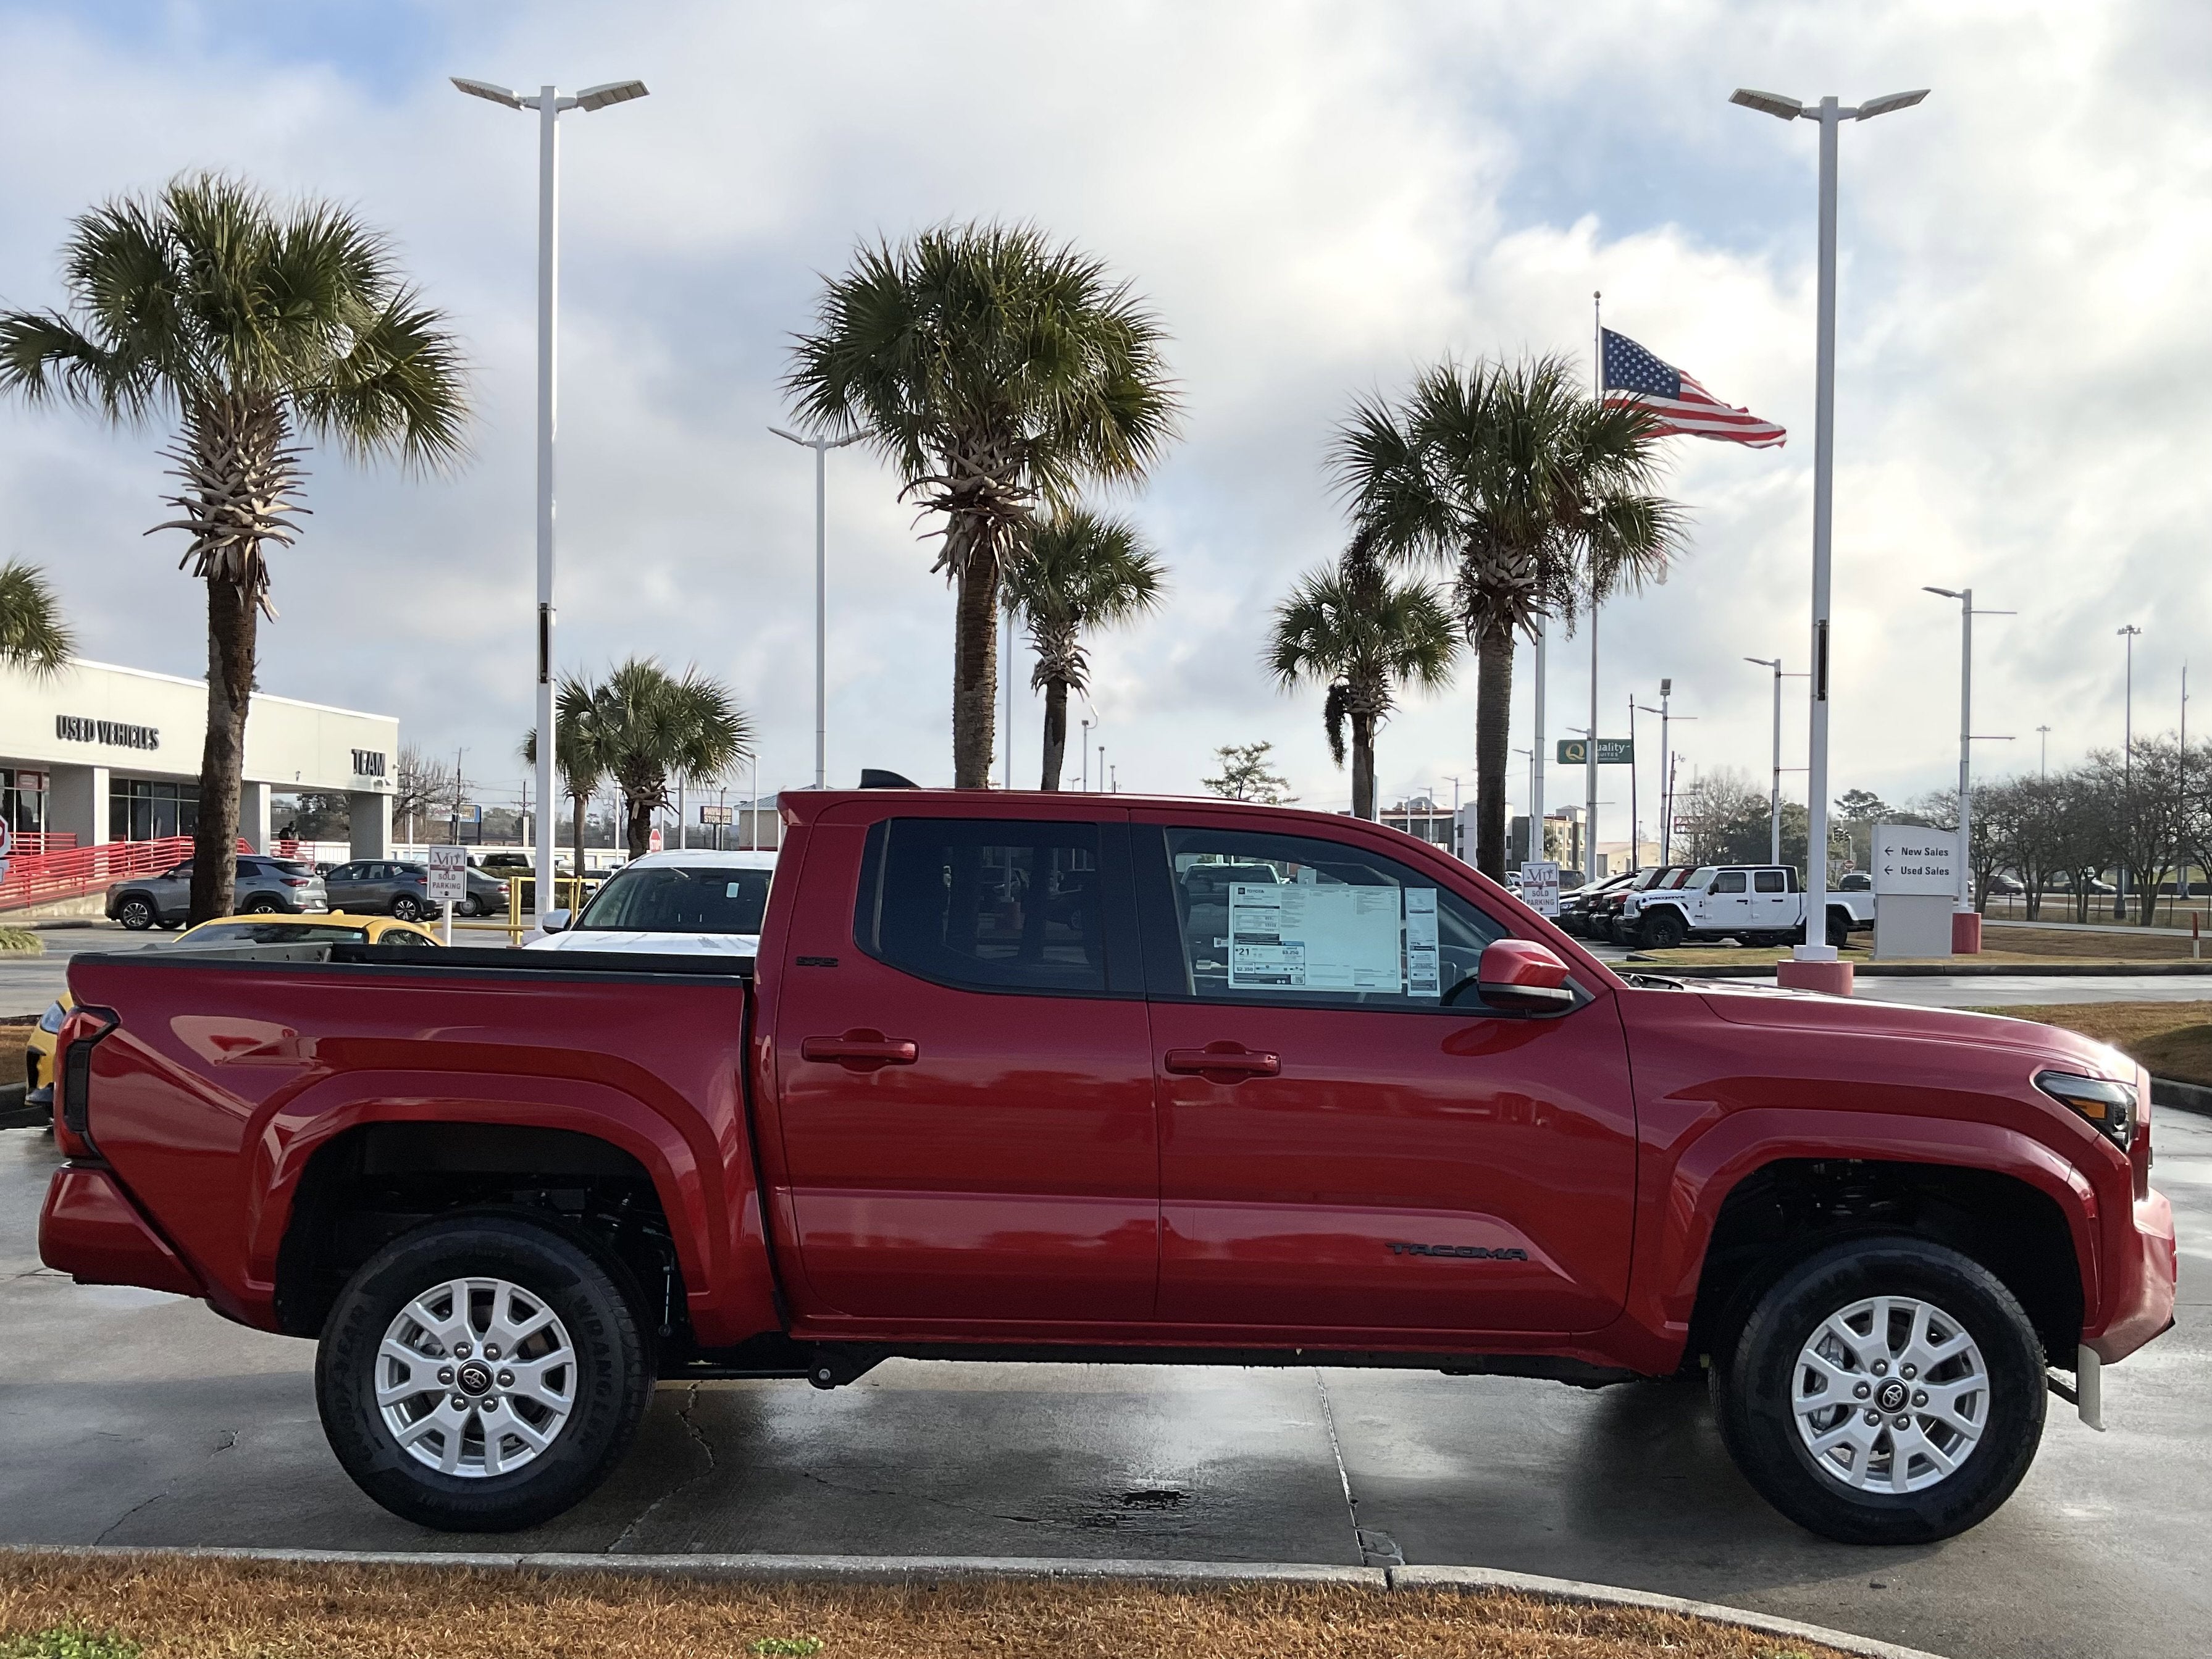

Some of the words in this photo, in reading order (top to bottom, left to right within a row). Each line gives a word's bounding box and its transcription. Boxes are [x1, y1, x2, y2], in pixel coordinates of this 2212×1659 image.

[56, 715, 96, 742] USED
[97, 720, 159, 750] VEHICLES
[1597, 742, 1625, 754] uality
[351, 749, 385, 776] TEAM
[1901, 847, 1922, 855] New
[1924, 847, 1949, 856] Sales
[1901, 866, 1922, 875] Used
[1925, 867, 1950, 875] Sales
[1238, 947, 1250, 956] 21
[1385, 1242, 1528, 1261] TACOMA
